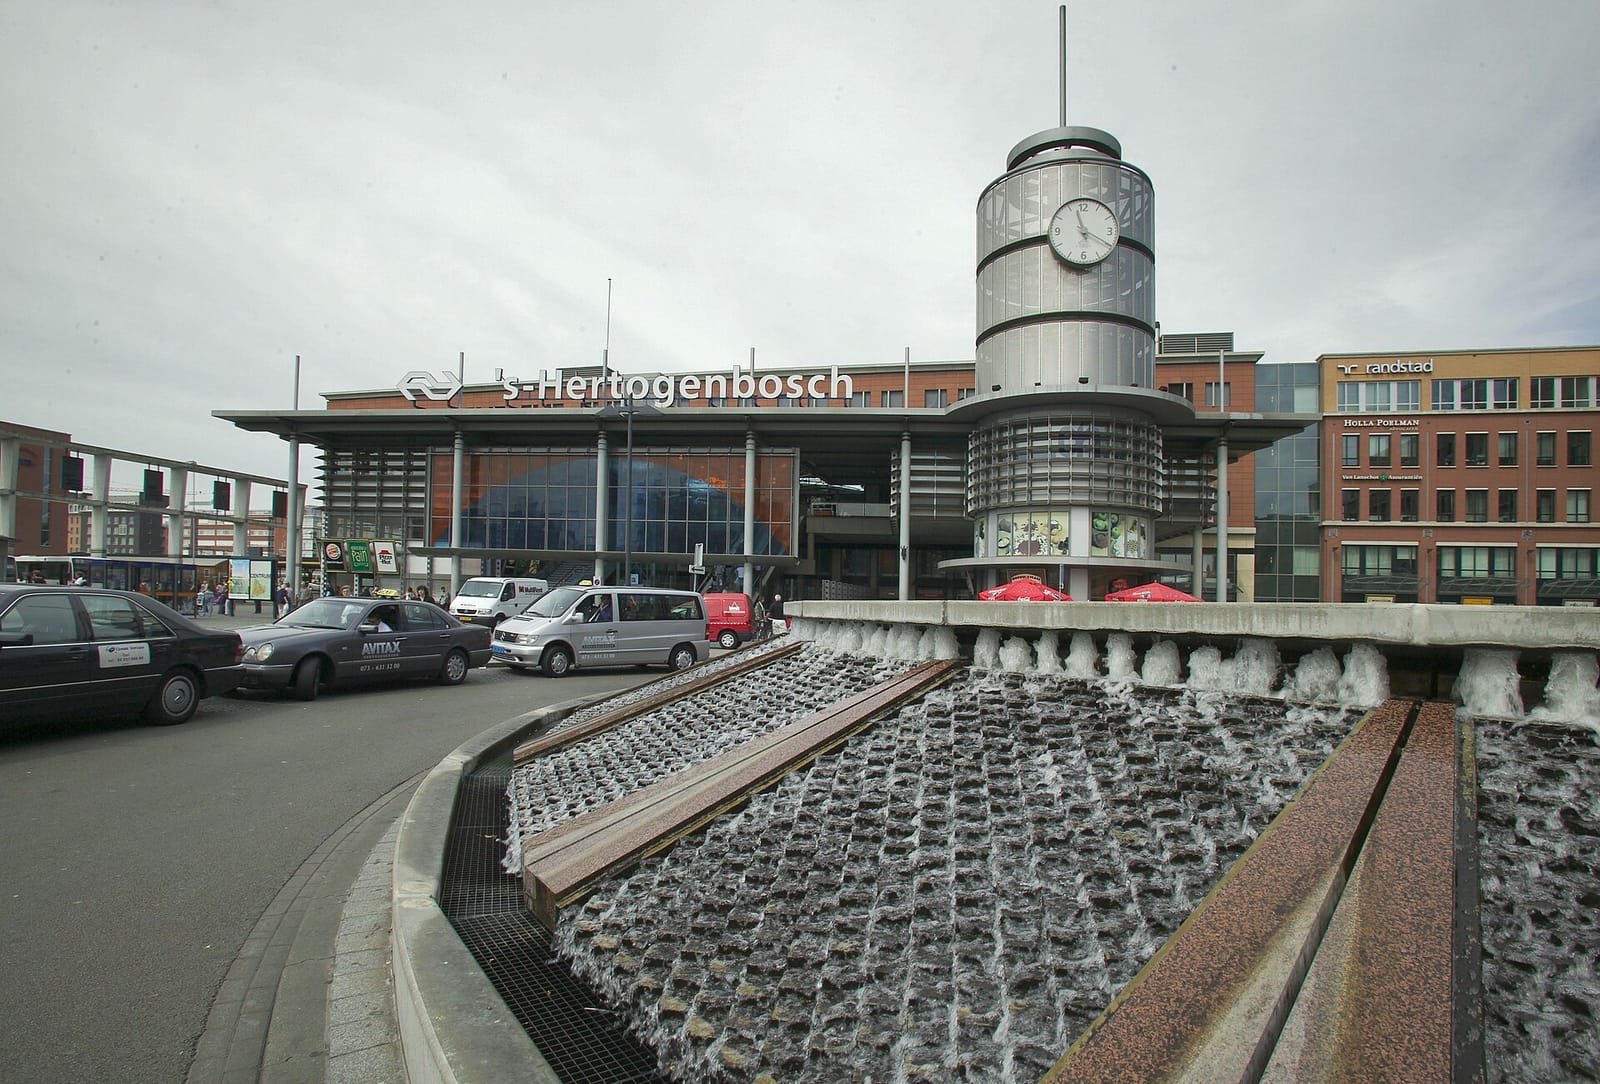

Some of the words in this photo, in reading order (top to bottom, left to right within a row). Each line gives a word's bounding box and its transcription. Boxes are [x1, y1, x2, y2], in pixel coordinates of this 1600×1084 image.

[1078, 203, 1089, 213] 12
[1054, 227, 1061, 236] 9
[1106, 227, 1113, 236] 3
[1080, 251, 1087, 260] 6
[1366, 359, 1433, 374] randstad
[495, 365, 853, 408] 's-Hertogenbosch
[1344, 419, 1374, 427] HOLLA
[1376, 419, 1419, 427] POELMAN
[361, 641, 401, 656] AVITAX
